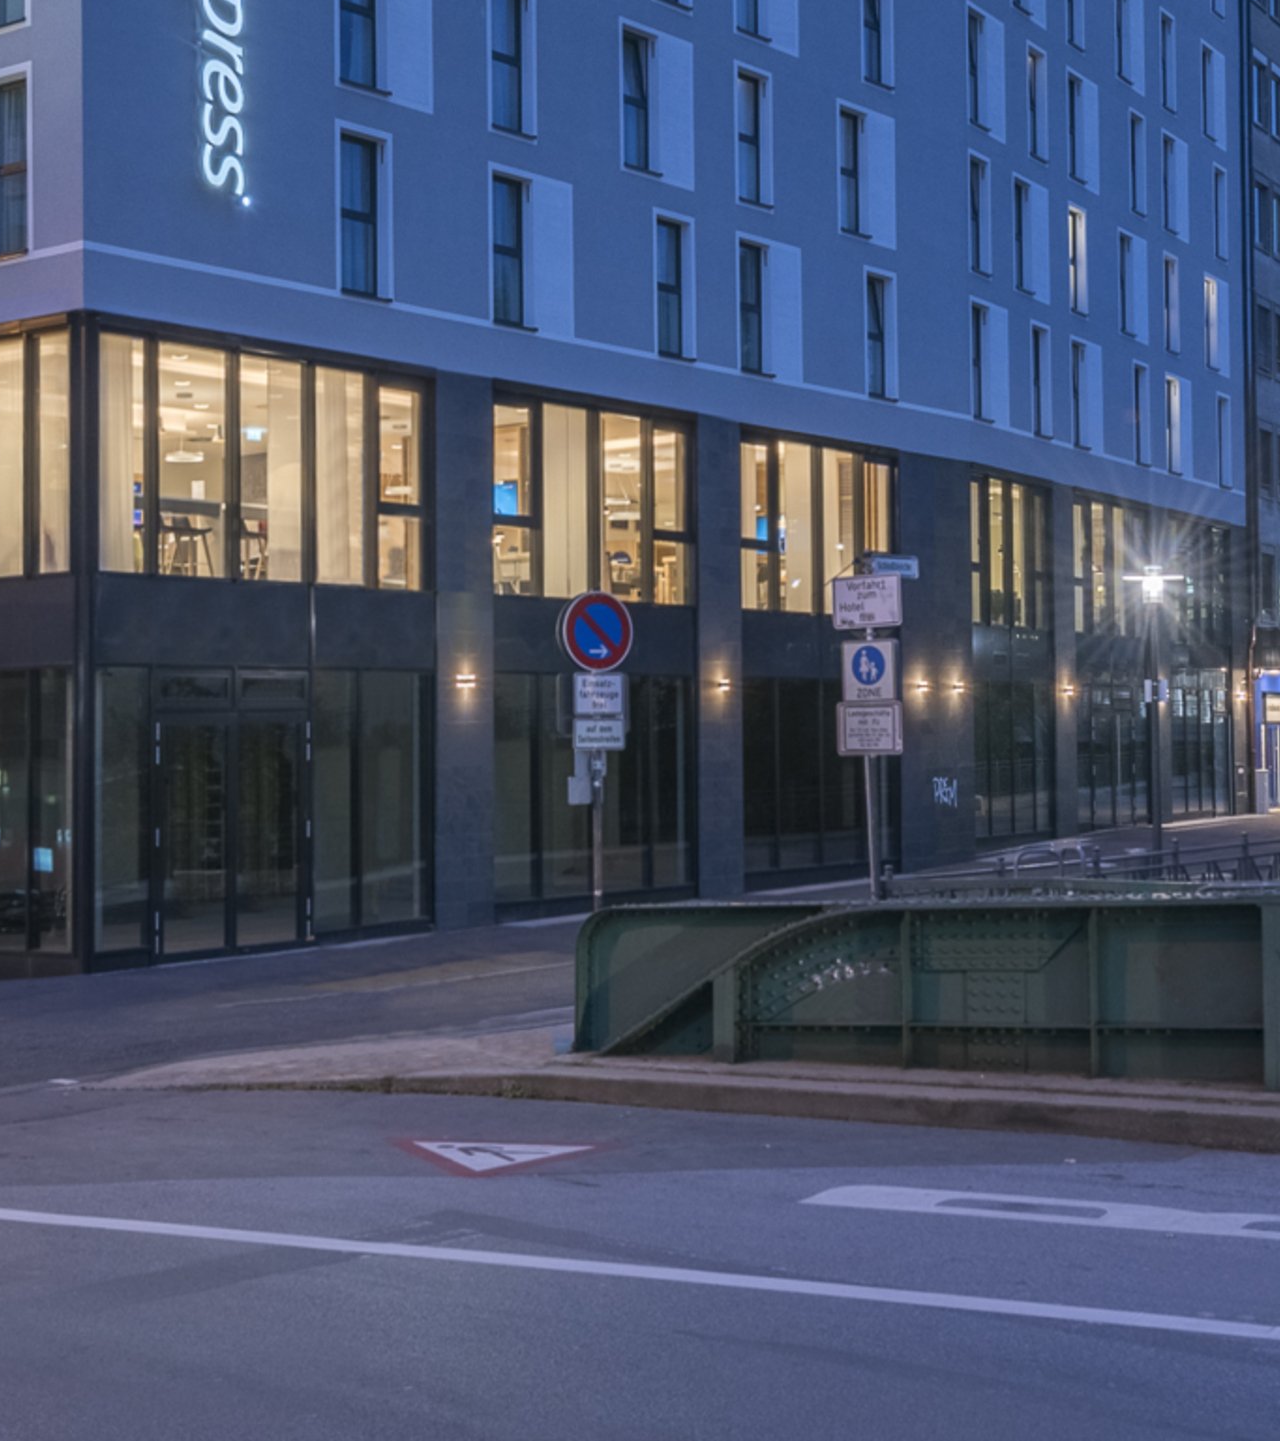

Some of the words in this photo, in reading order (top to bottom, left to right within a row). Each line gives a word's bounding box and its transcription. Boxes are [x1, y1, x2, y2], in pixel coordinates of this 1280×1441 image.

[857, 591, 878, 600] zum
[839, 601, 865, 613] Hotel
[856, 687, 882, 699] ZONE
